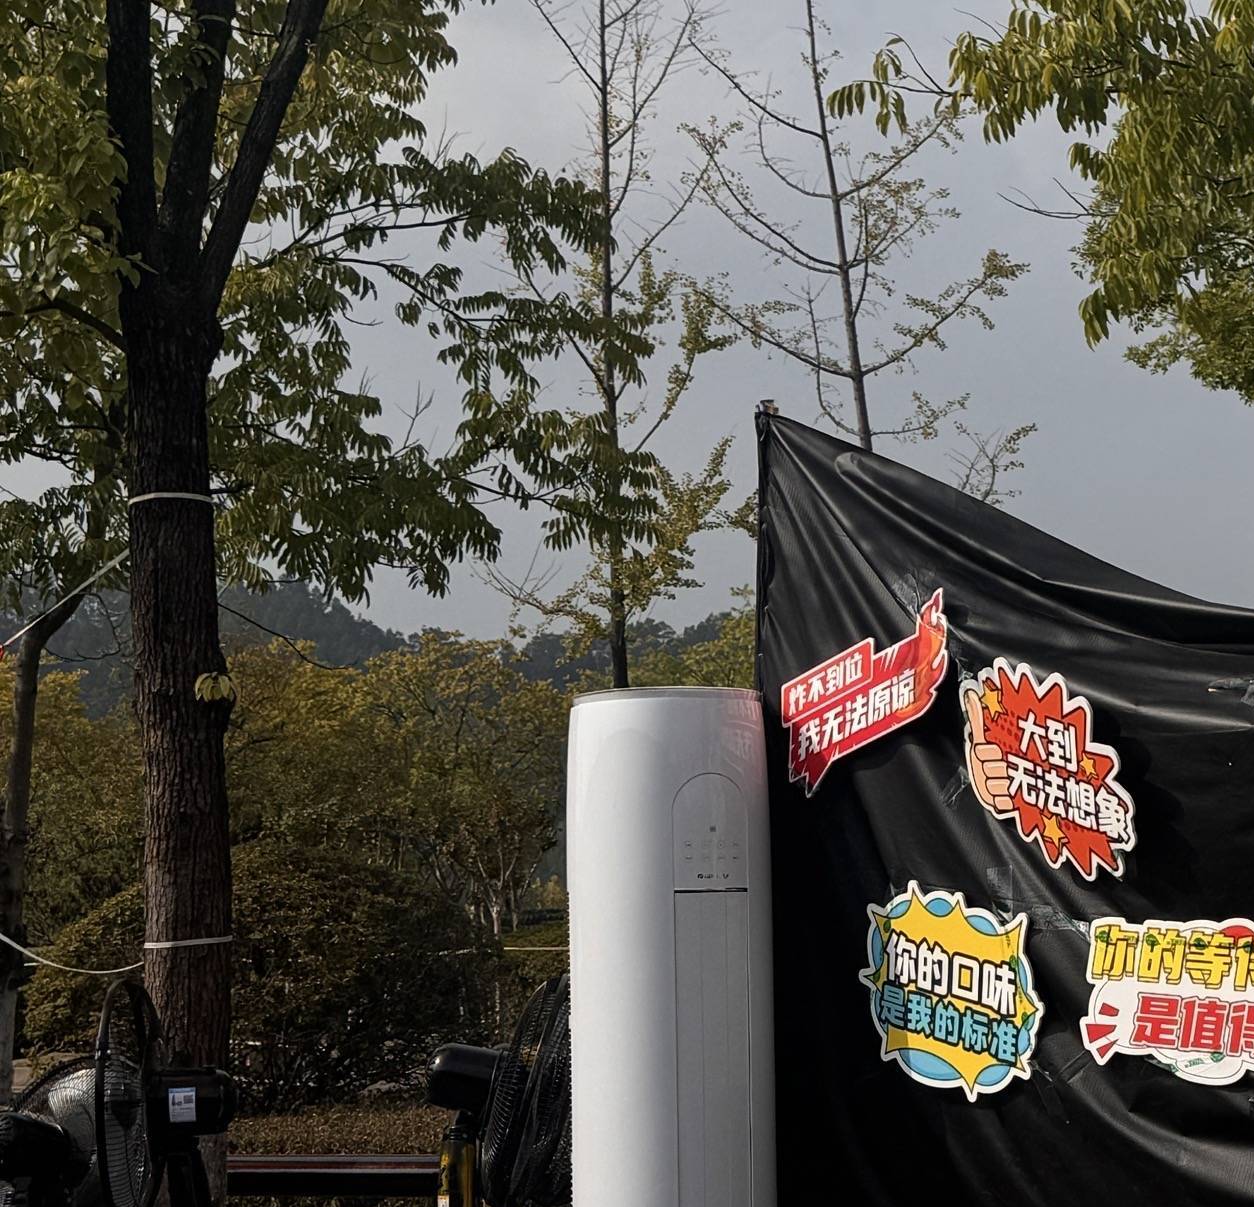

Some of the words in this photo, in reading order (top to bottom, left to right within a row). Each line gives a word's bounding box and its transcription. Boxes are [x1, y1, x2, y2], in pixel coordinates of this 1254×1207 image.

[789, 653, 863, 716] 炸不到位
[797, 668, 916, 762] 我无法原谅
[1018, 714, 1077, 770] 大到
[1006, 753, 1131, 843] 无法想象
[885, 930, 1018, 1017] 你的口味
[879, 984, 1018, 1064] 是我的标准
